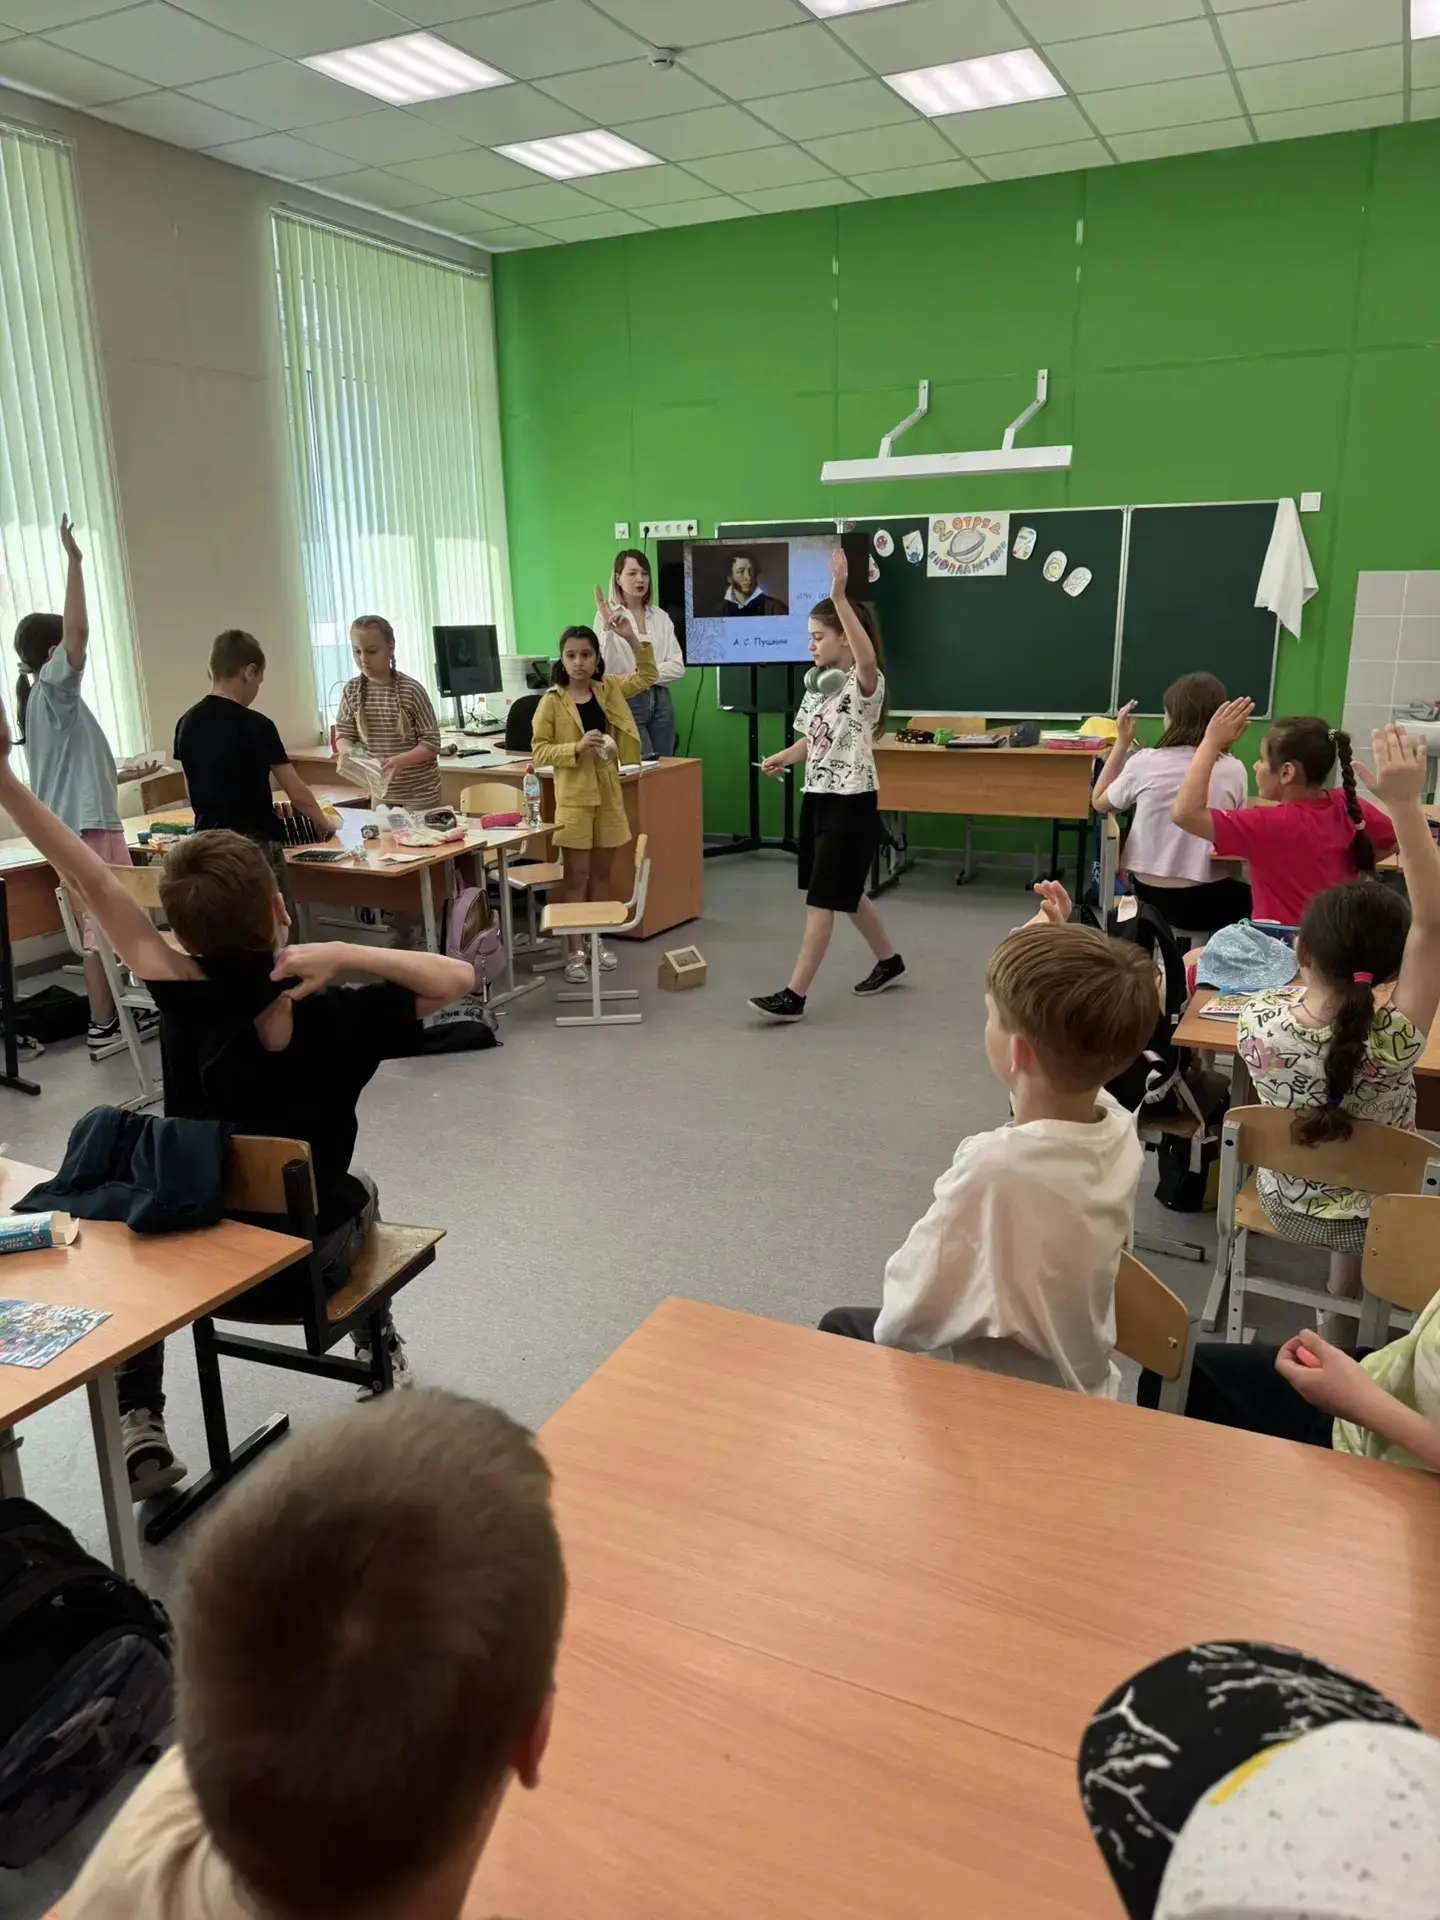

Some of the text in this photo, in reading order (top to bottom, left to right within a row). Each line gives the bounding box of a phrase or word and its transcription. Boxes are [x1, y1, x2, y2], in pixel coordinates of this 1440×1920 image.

[933, 516, 1001, 542] 2 ОТРЯД
[754, 637, 788, 648] Пушкин
